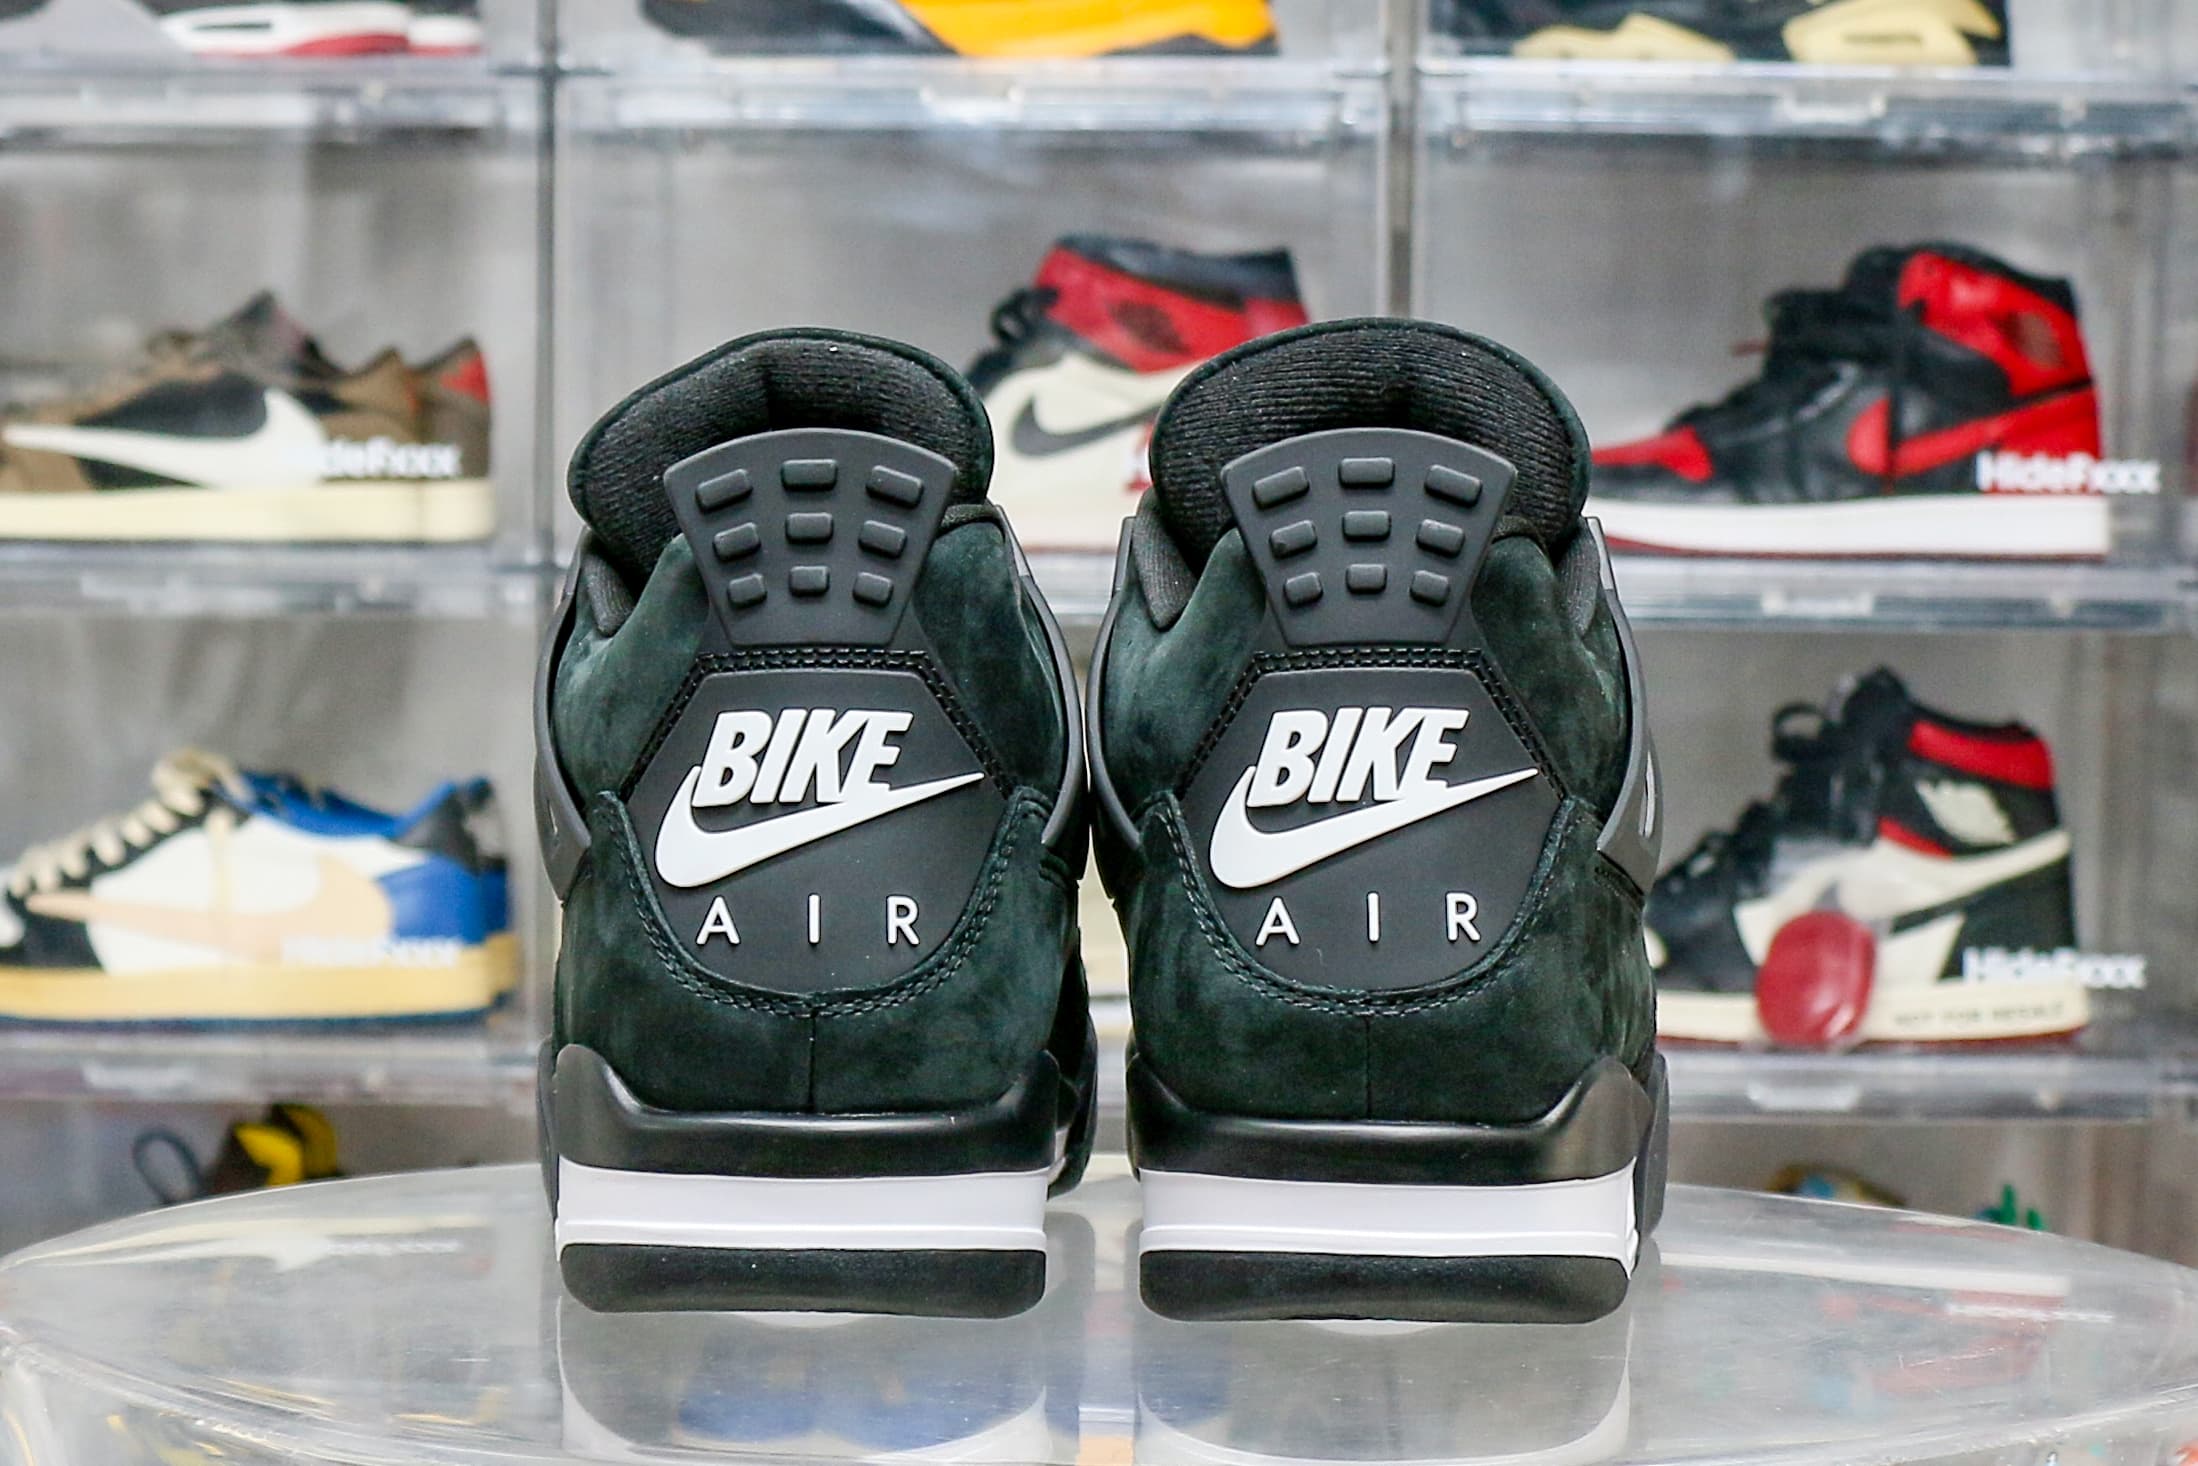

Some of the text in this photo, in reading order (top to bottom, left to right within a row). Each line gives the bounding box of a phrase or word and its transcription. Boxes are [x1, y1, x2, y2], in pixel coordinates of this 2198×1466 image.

[692, 708, 914, 807] BIKE
[1246, 706, 1470, 808] BIKE
[696, 894, 920, 945] AIR
[1255, 892, 1482, 946] AIR
